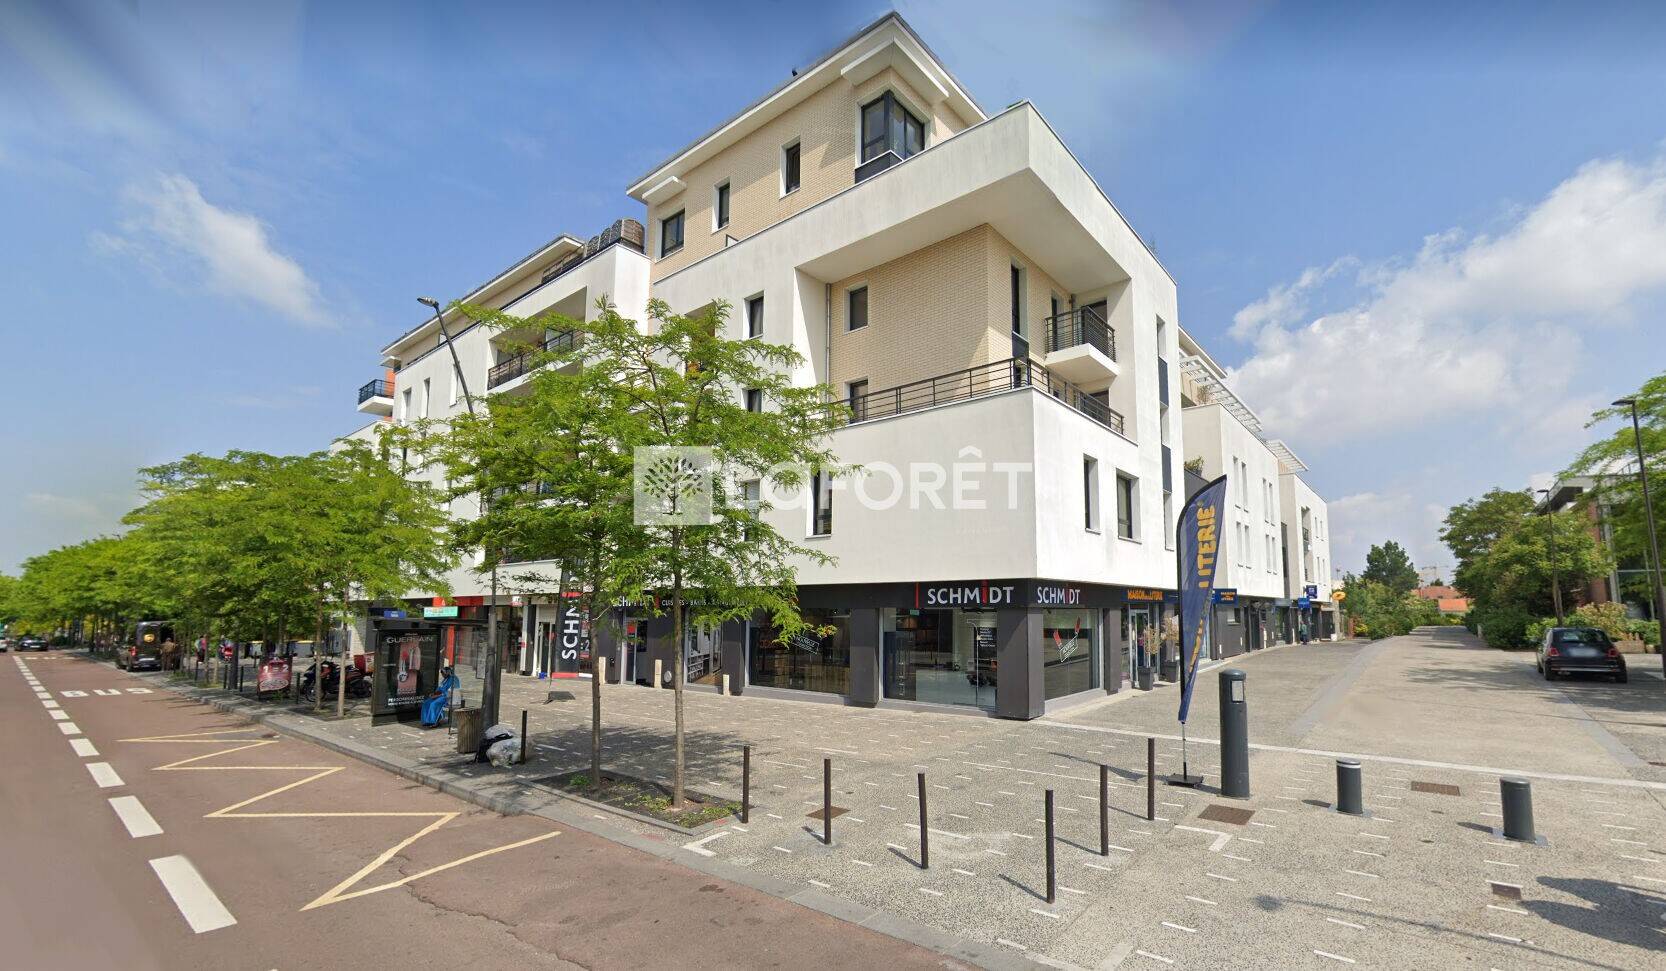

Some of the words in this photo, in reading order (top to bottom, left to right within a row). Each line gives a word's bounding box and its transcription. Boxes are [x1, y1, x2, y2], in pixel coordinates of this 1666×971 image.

[927, 583, 1015, 605] SCHMIDT
[1037, 586, 1081, 605] SCHMIDT
[561, 571, 582, 661] SCHMI
[59, 687, 155, 698] BUS
